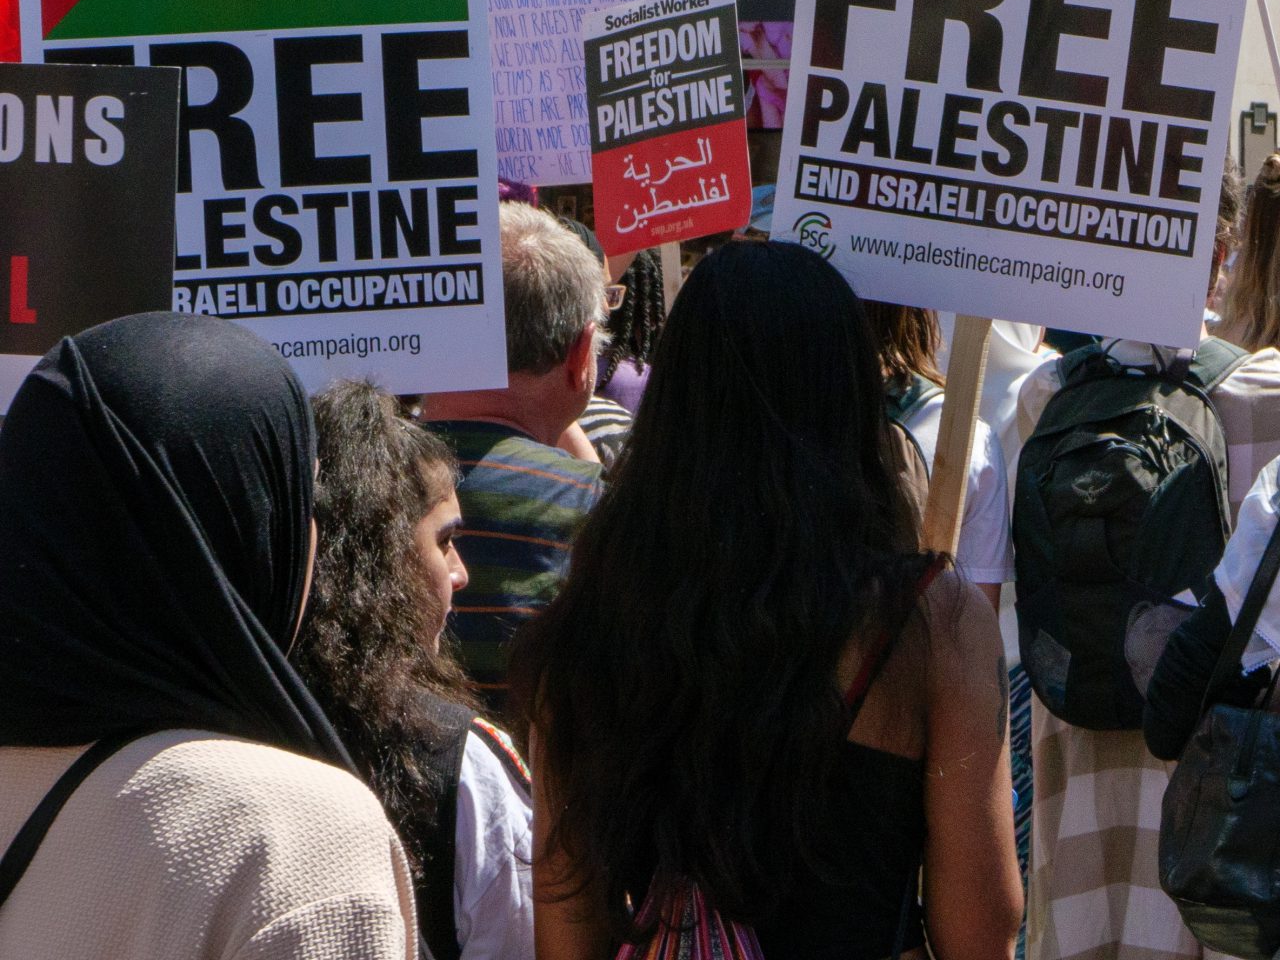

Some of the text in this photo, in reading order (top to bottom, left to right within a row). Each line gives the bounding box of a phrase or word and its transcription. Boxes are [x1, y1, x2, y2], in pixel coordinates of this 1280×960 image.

[605, 2, 660, 30] Socialist
[600, 17, 721, 82] FREEDOM
[650, 69, 671, 87] for
[43, 30, 479, 193] REE
[597, 74, 735, 142] PALESTINE
[800, 74, 1208, 203] PALESTINE
[623, 137, 713, 188] الحرية
[616, 173, 730, 233] لفلسطين
[799, 163, 1192, 252] END ISRAELI OCCUPATION
[277, 270, 478, 311] OCCUPATION
[850, 235, 1125, 296] www.palestinecampaign.org
